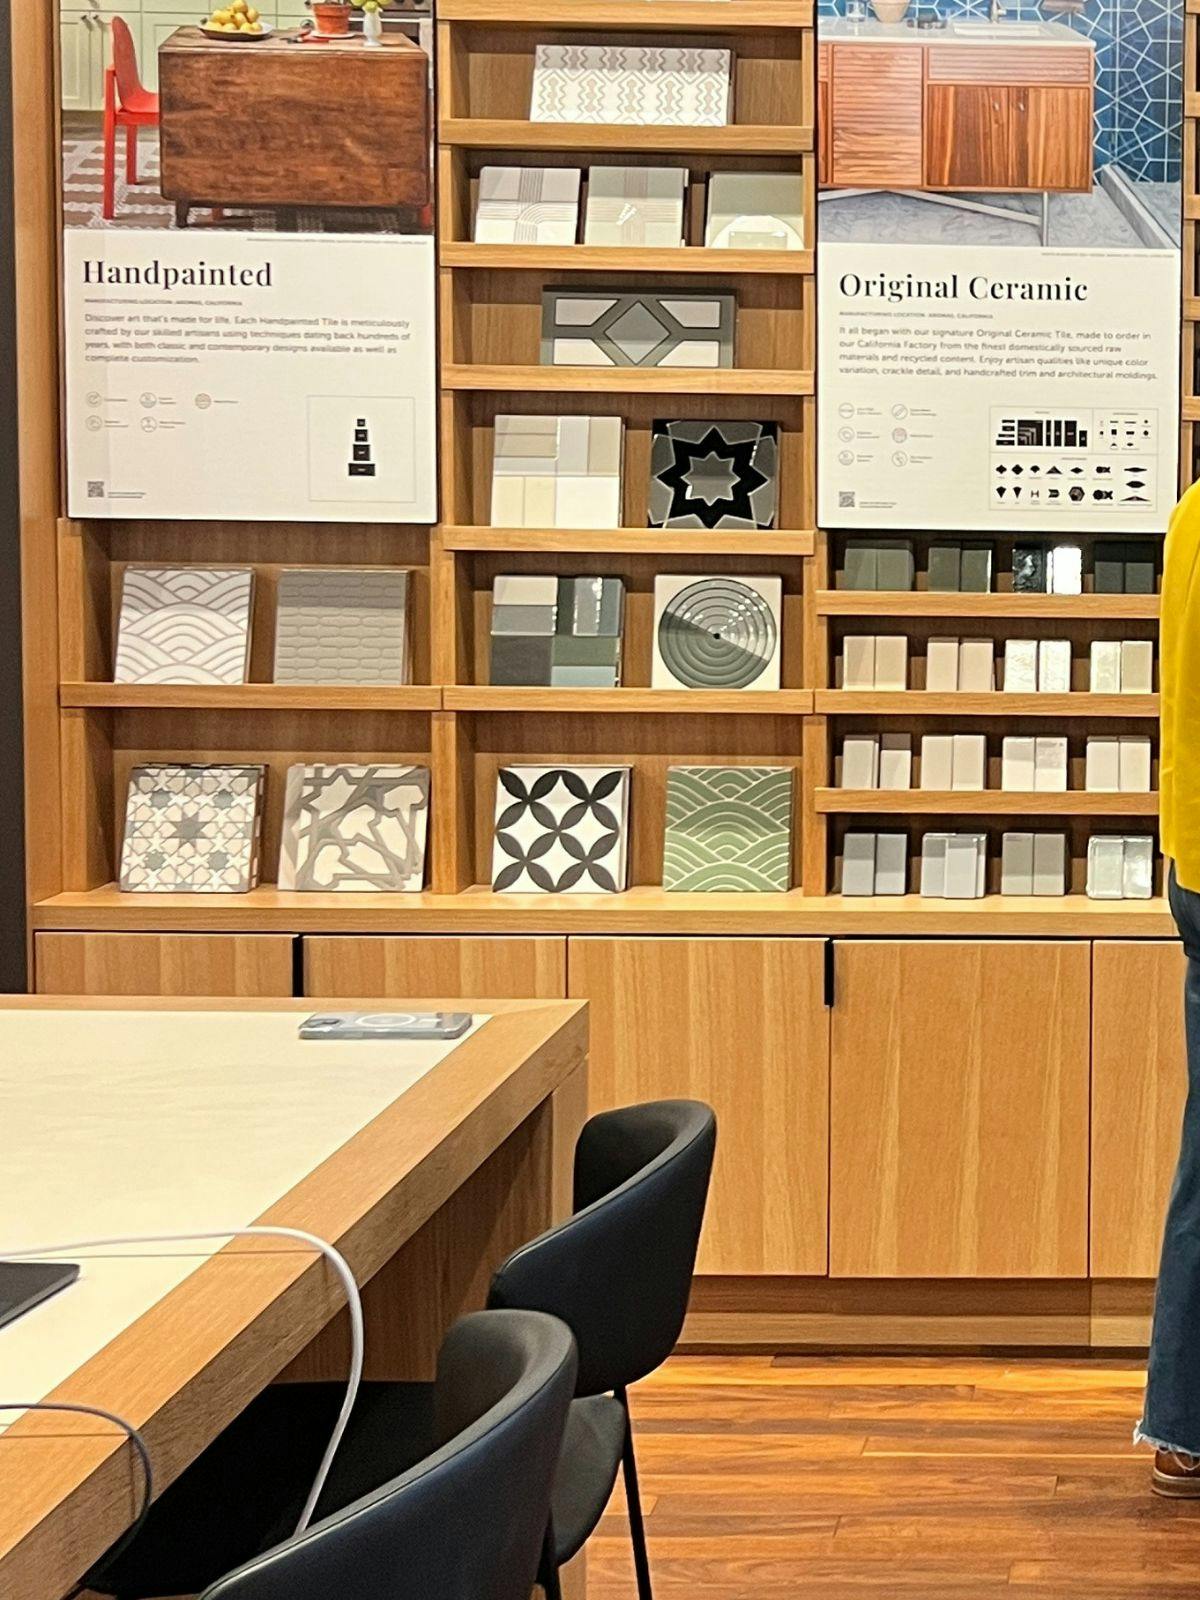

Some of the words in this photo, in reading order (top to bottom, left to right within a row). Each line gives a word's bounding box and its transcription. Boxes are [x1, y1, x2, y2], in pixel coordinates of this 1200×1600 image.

[83, 260, 274, 290] Handpainted
[840, 273, 958, 303] Original
[969, 276, 1088, 302] Ceramic
[84, 314, 125, 322] Discover
[170, 315, 196, 323] made
[84, 327, 118, 335] crafted
[119, 327, 132, 337] by
[184, 328, 220, 336] artisans
[222, 329, 248, 339] using
[303, 330, 332, 340] dating
[356, 331, 399, 339] hundreds
[861, 327, 889, 337] began
[932, 328, 974, 338] signature
[976, 329, 1012, 339] Original
[1014, 330, 1052, 338] Ceramic
[1075, 331, 1101, 339] made
[1115, 331, 1140, 339] order
[156, 342, 186, 350] classic
[207, 342, 270, 352] contemporary
[272, 343, 308, 353] designs
[310, 344, 350, 352] available
[856, 340, 901, 348] California
[903, 341, 937, 351] Factory
[940, 341, 962, 349] from
[981, 342, 1006, 350] finest
[1008, 342, 1065, 353] domestically
[1068, 343, 1103, 352] sourced
[84, 354, 130, 364] complete
[839, 353, 879, 361] materials
[900, 354, 938, 364] recycled
[978, 355, 1004, 365] Enjoy
[1005, 356, 1035, 364] artisan
[1036, 356, 1073, 366] qualities
[1092, 357, 1123, 367] unique
[1125, 358, 1148, 366] color
[881, 367, 914, 375] crackle
[963, 368, 1016, 377] handcrafted
[1057, 370, 1113, 378] architectural
[1115, 371, 1158, 381] moldings.
